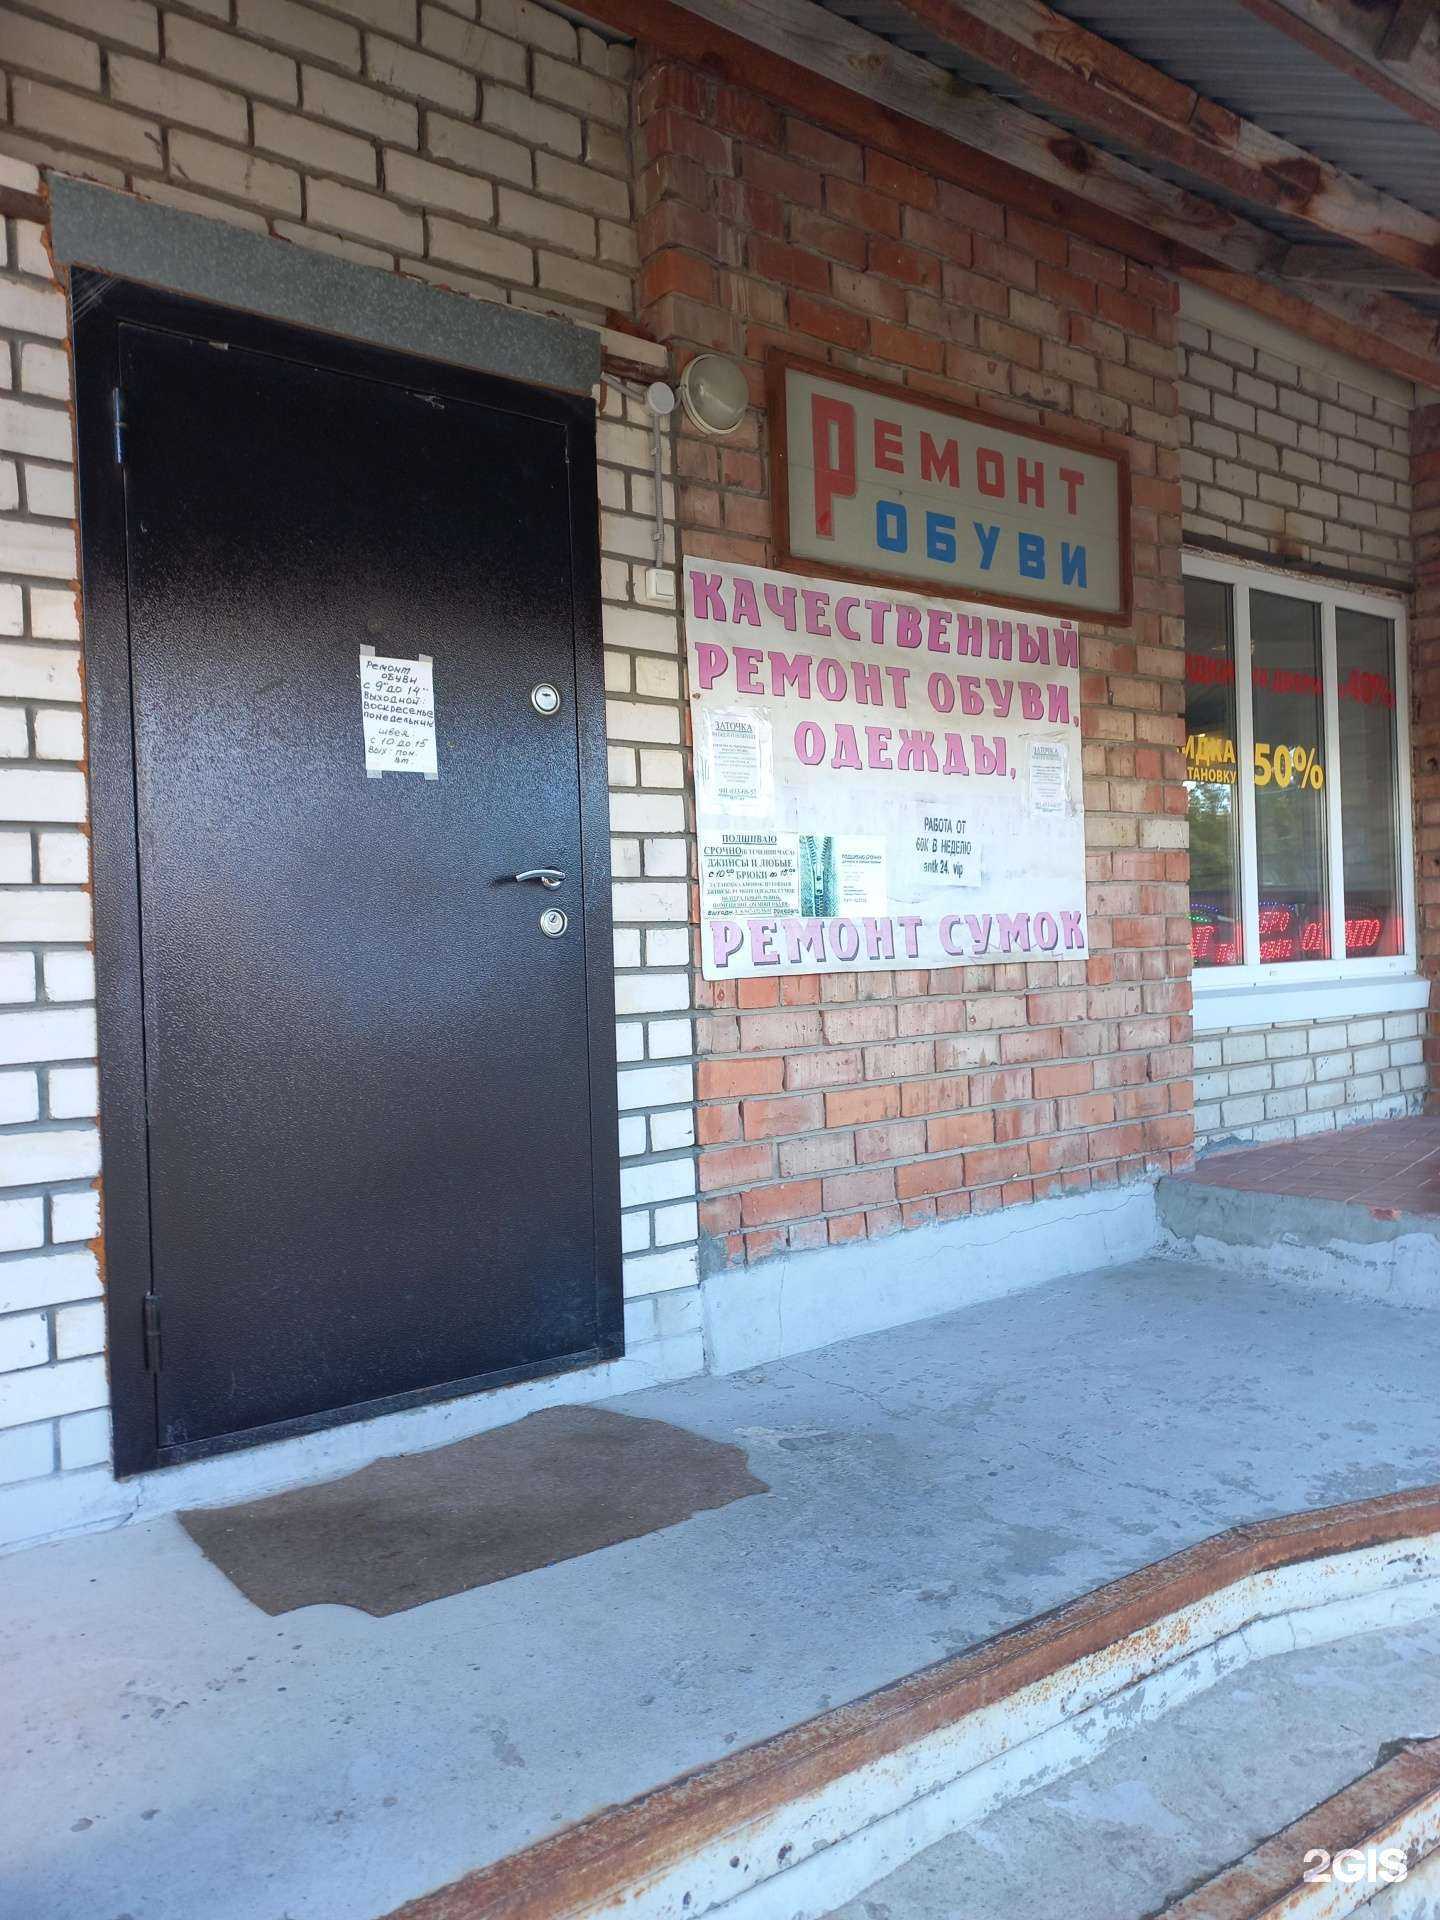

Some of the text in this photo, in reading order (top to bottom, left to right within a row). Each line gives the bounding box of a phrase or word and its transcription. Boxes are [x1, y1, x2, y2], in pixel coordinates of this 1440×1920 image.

[811, 393, 1085, 540] РЕМОНТ
[875, 499, 1088, 589] ОБУВИ
[690, 570, 1078, 668] КАЧЕСТВЕННЫЙ
[694, 641, 1080, 728] РЕМОНТ ОБУВИ,
[714, 720, 753, 734] ЗАТОЧКА
[794, 719, 1018, 782] ОДЕЖДЫ,
[1255, 743, 1324, 790] 50%
[722, 834, 777, 844] ПОДШИВАЮ
[924, 817, 967, 834] РАБОТА ОТ
[703, 846, 742, 855] СРОЧНО
[707, 858, 793, 868] ДЖИНСЫ И ЛЮБЫЕ
[932, 838, 938, 853] В
[941, 839, 972, 856] НЕДЕЛЮ
[736, 870, 768, 880] БРЮКИ
[709, 910, 1085, 968] РЕМОНТ СУМОК
